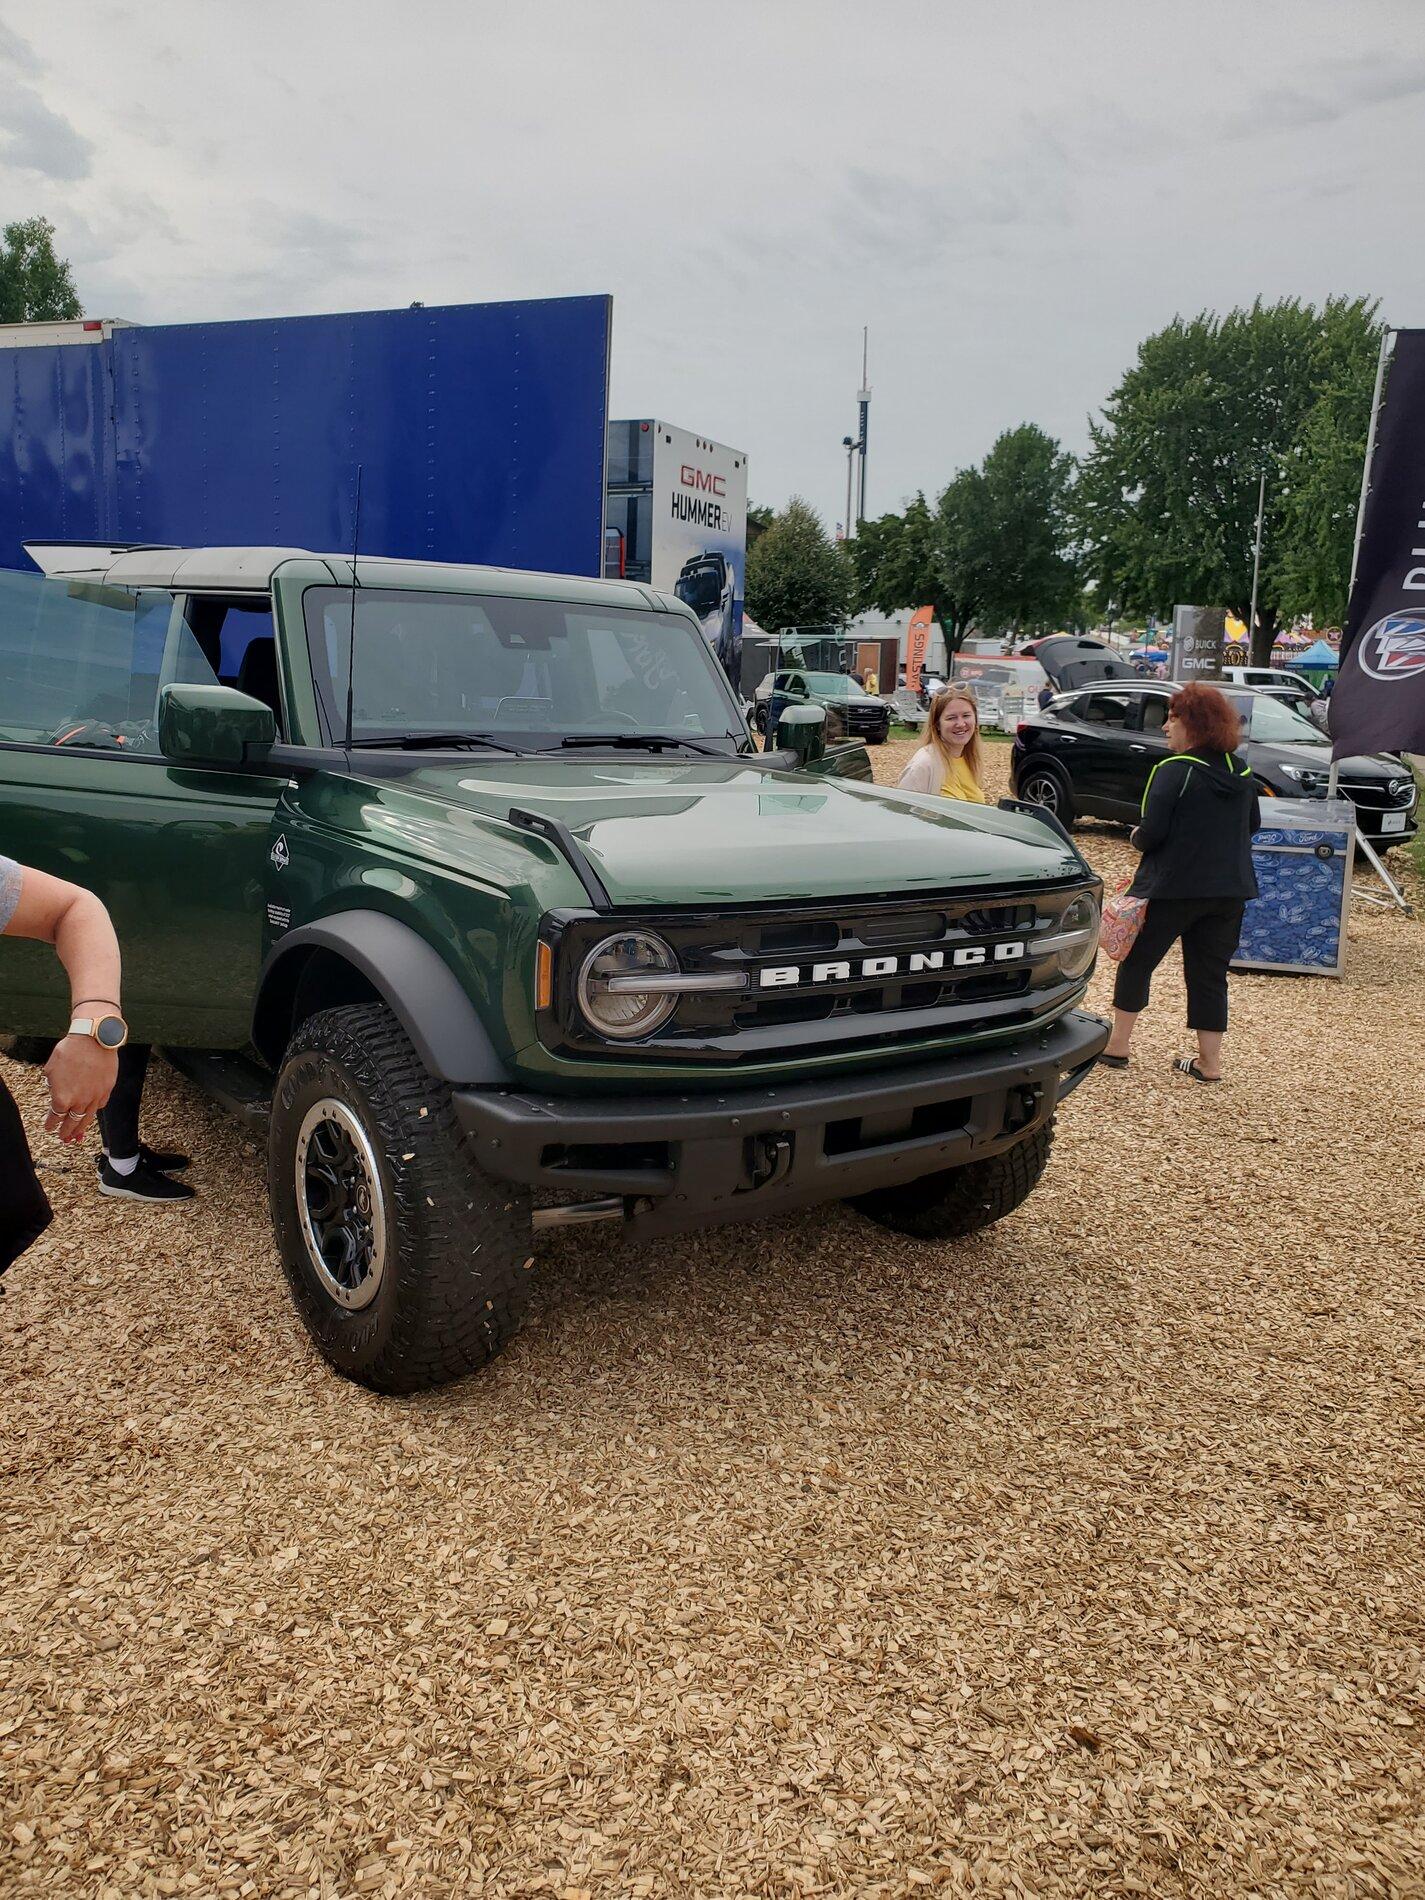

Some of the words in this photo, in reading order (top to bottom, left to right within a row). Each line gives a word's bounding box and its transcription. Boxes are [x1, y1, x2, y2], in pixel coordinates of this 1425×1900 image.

[681, 465, 726, 496] GMC
[671, 492, 721, 531] HUMMER
[1194, 640, 1217, 649] BUICK
[1182, 658, 1216, 669] GMC
[1298, 832, 1319, 843] Ford
[760, 942, 1024, 987] BRONCO
